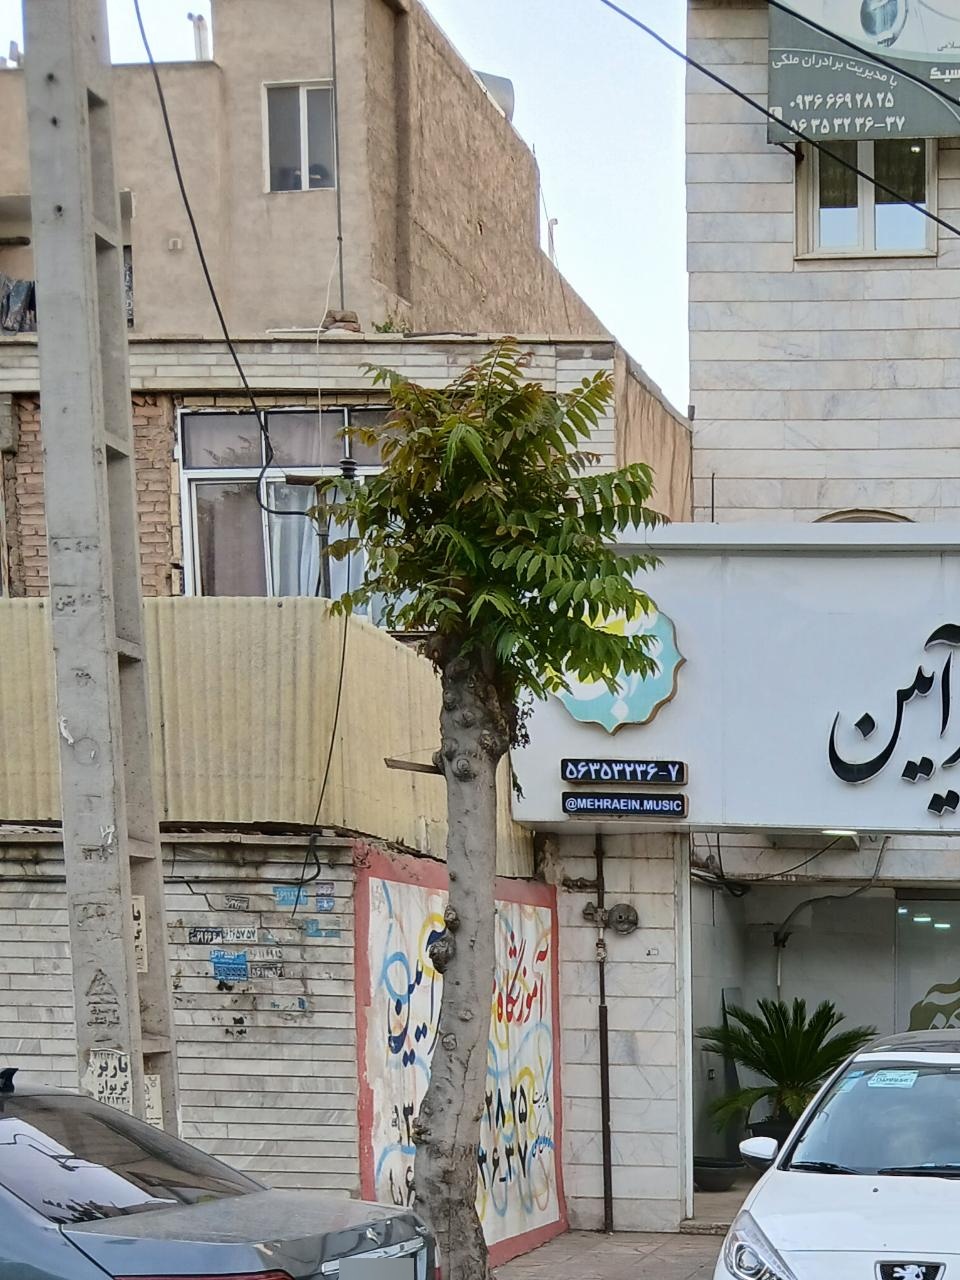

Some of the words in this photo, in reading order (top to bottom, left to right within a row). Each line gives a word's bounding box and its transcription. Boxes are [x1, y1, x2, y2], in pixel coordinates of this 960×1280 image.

[772, 54, 800, 69] ملکی
[801, 54, 843, 71] برادران
[845, 61, 889, 82] مدیریت
[889, 75, 898, 89] با
[565, 797, 682, 812] @MEHRAEIN.MUSIC
